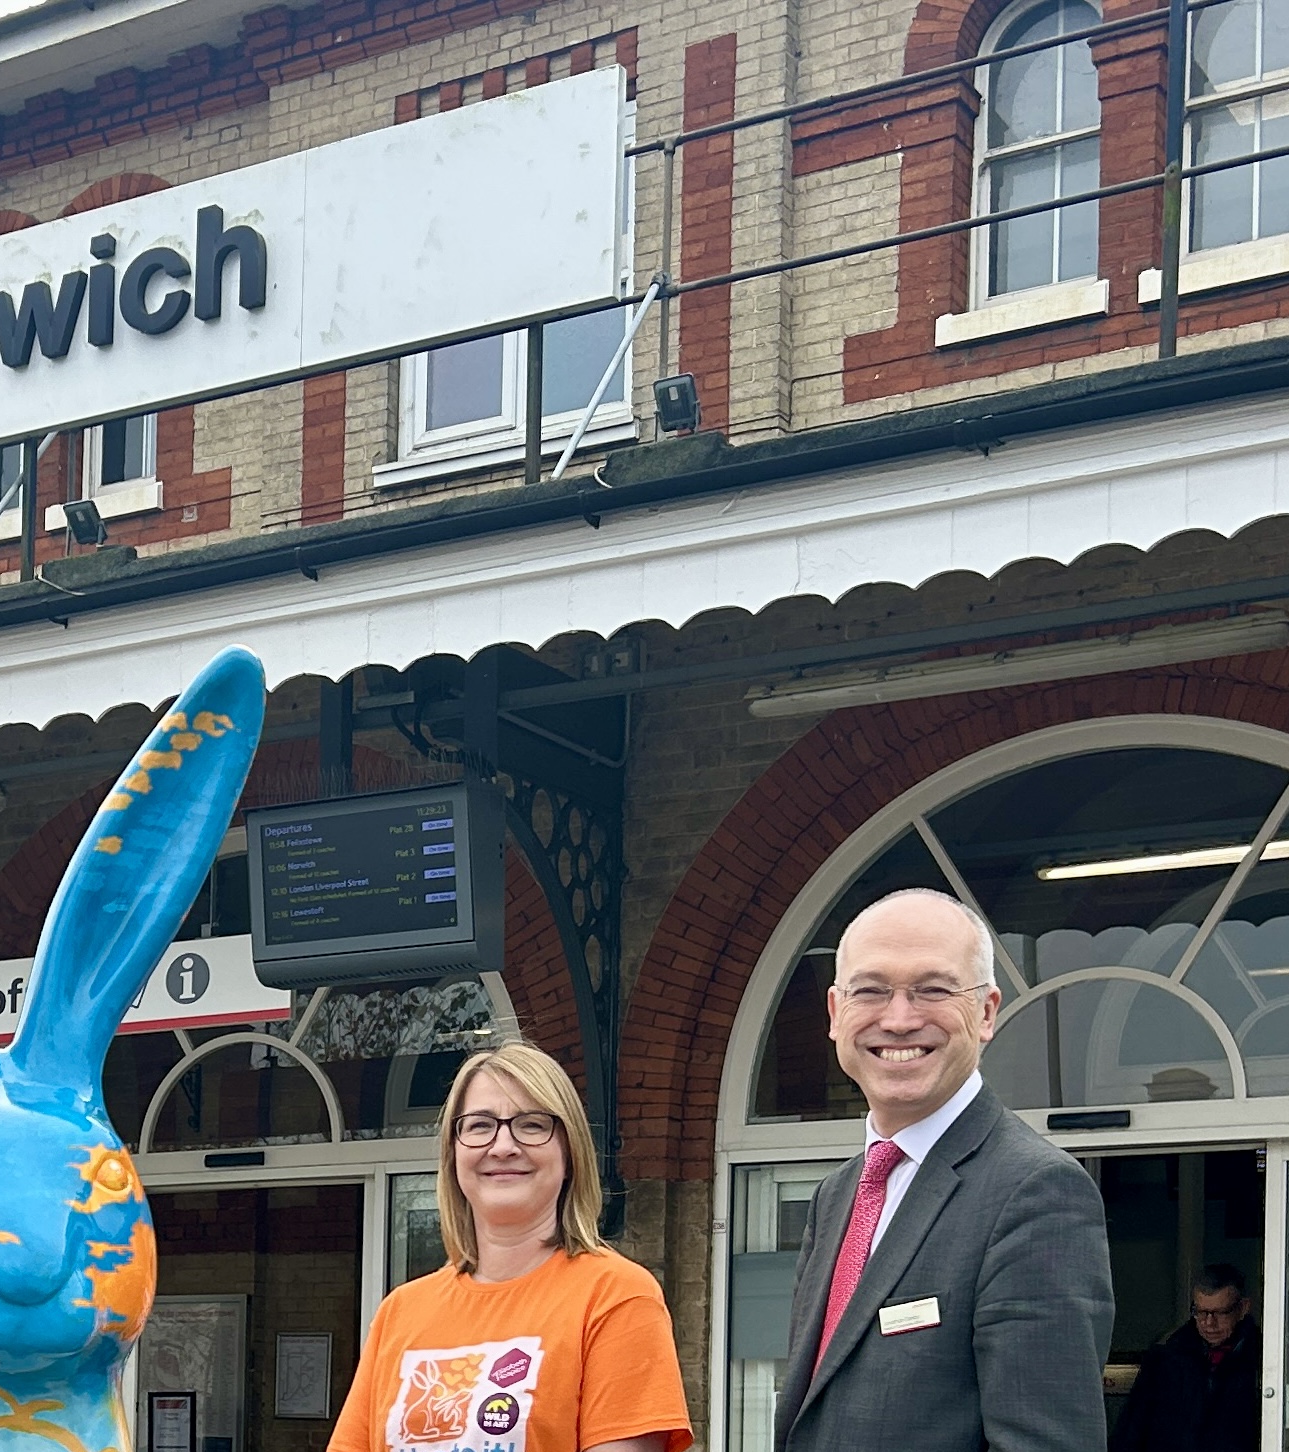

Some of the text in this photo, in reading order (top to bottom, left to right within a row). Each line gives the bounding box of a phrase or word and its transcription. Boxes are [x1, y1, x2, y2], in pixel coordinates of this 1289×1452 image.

[265, 823, 312, 837] Departures
[287, 861, 316, 871] Norwich
[289, 885, 314, 894] London
[315, 880, 346, 891] Liverpool
[347, 878, 369, 887] Street
[290, 906, 324, 917] Lowestoft
[483, 1412, 510, 1422] WILD
